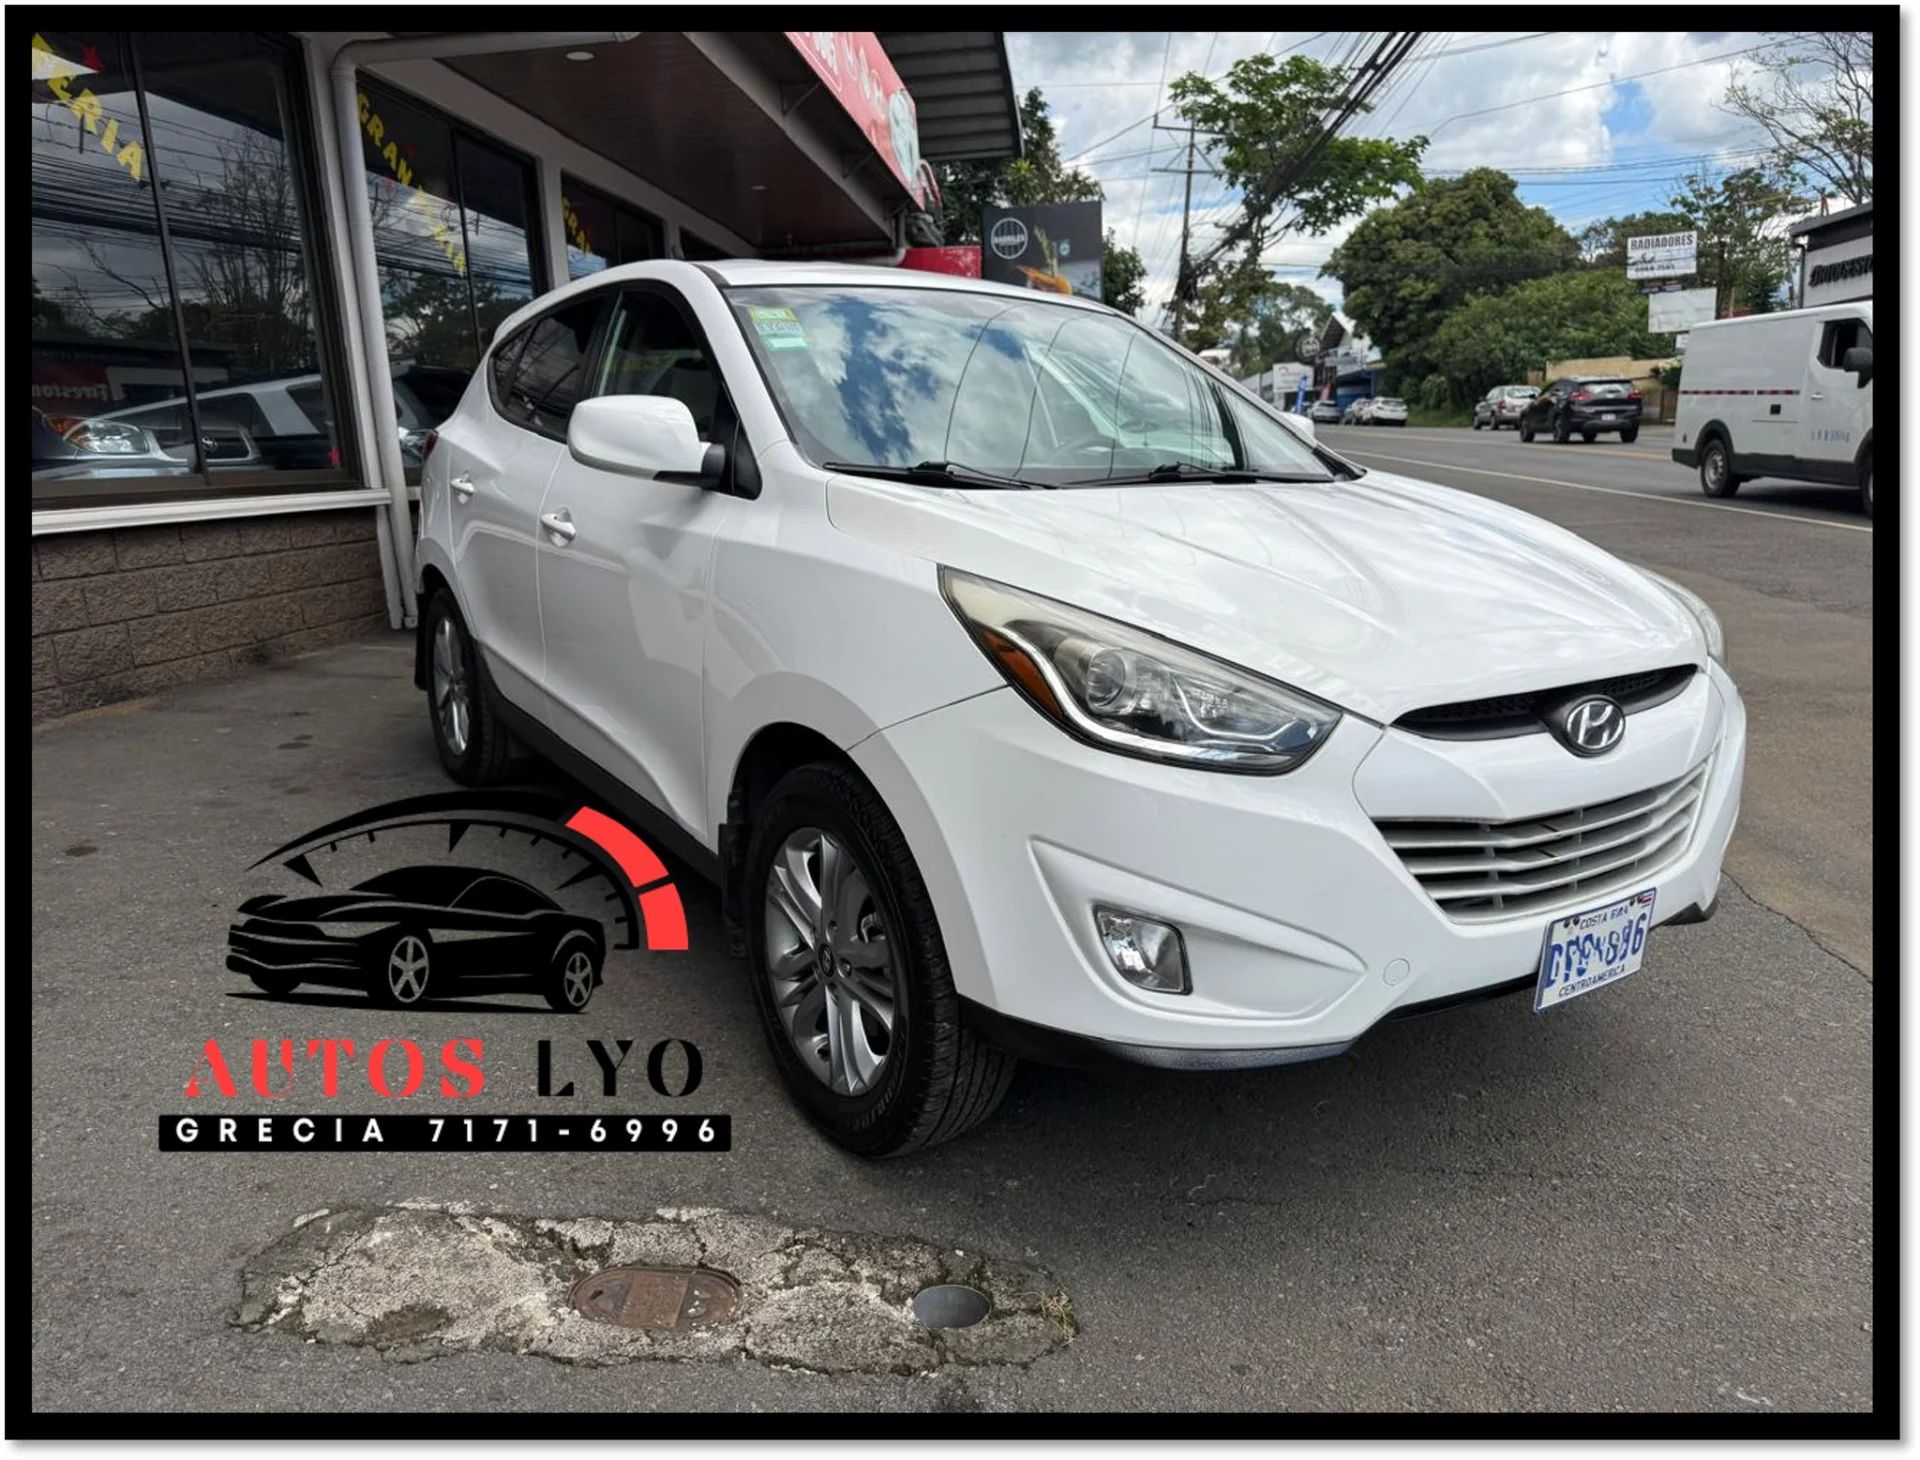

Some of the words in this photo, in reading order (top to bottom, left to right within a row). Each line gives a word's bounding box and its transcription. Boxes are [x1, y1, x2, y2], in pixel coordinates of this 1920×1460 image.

[1630, 234, 1693, 251] RADIADORES
[1580, 914, 1607, 930] COSTA
[1558, 964, 1625, 998] CENTROAMERICA
